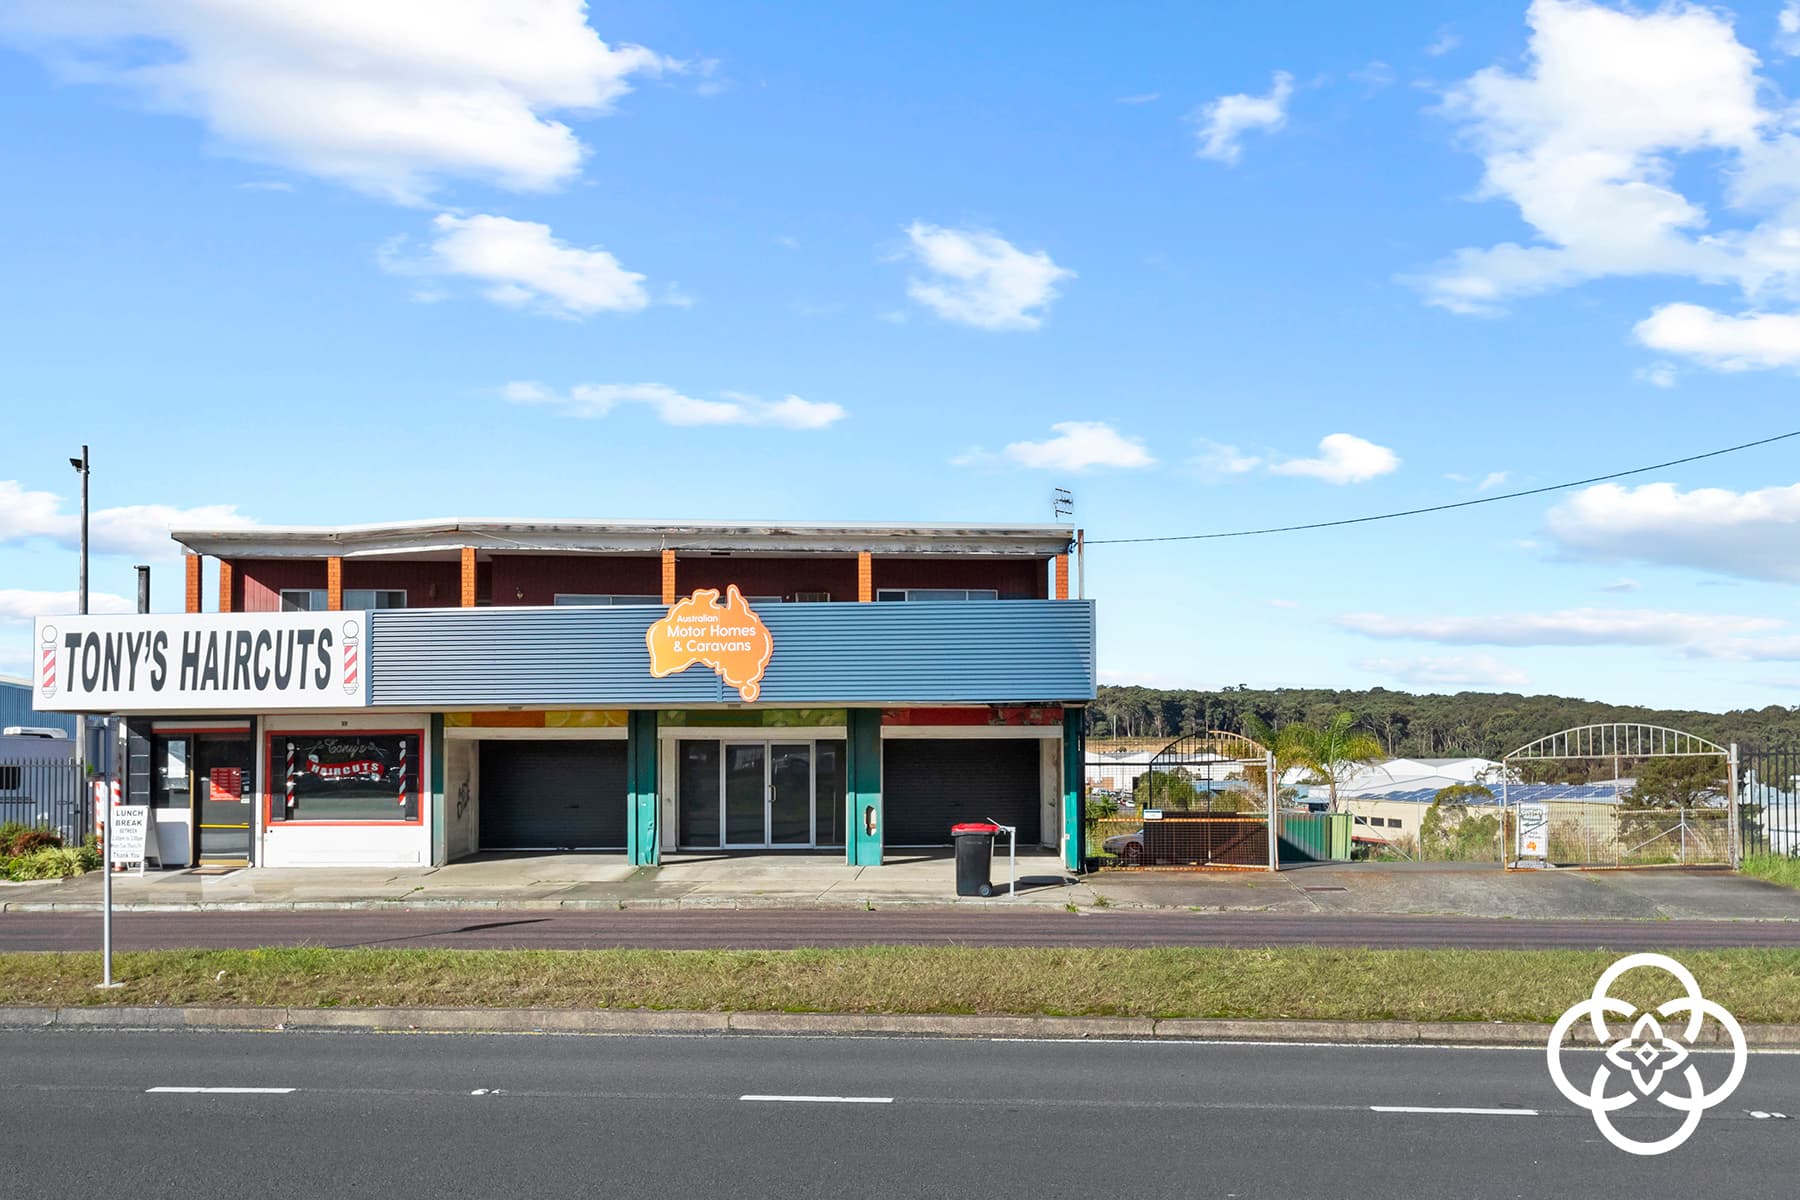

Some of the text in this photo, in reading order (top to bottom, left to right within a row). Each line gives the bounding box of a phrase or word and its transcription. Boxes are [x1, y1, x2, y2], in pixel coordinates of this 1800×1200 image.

[677, 614, 718, 623] Australian
[667, 625, 756, 637] Motor Homes
[673, 640, 751, 652] & Caravans
[65, 628, 333, 693] TONY'S HAIRCUTS
[311, 763, 379, 776] HAIRCUTS
